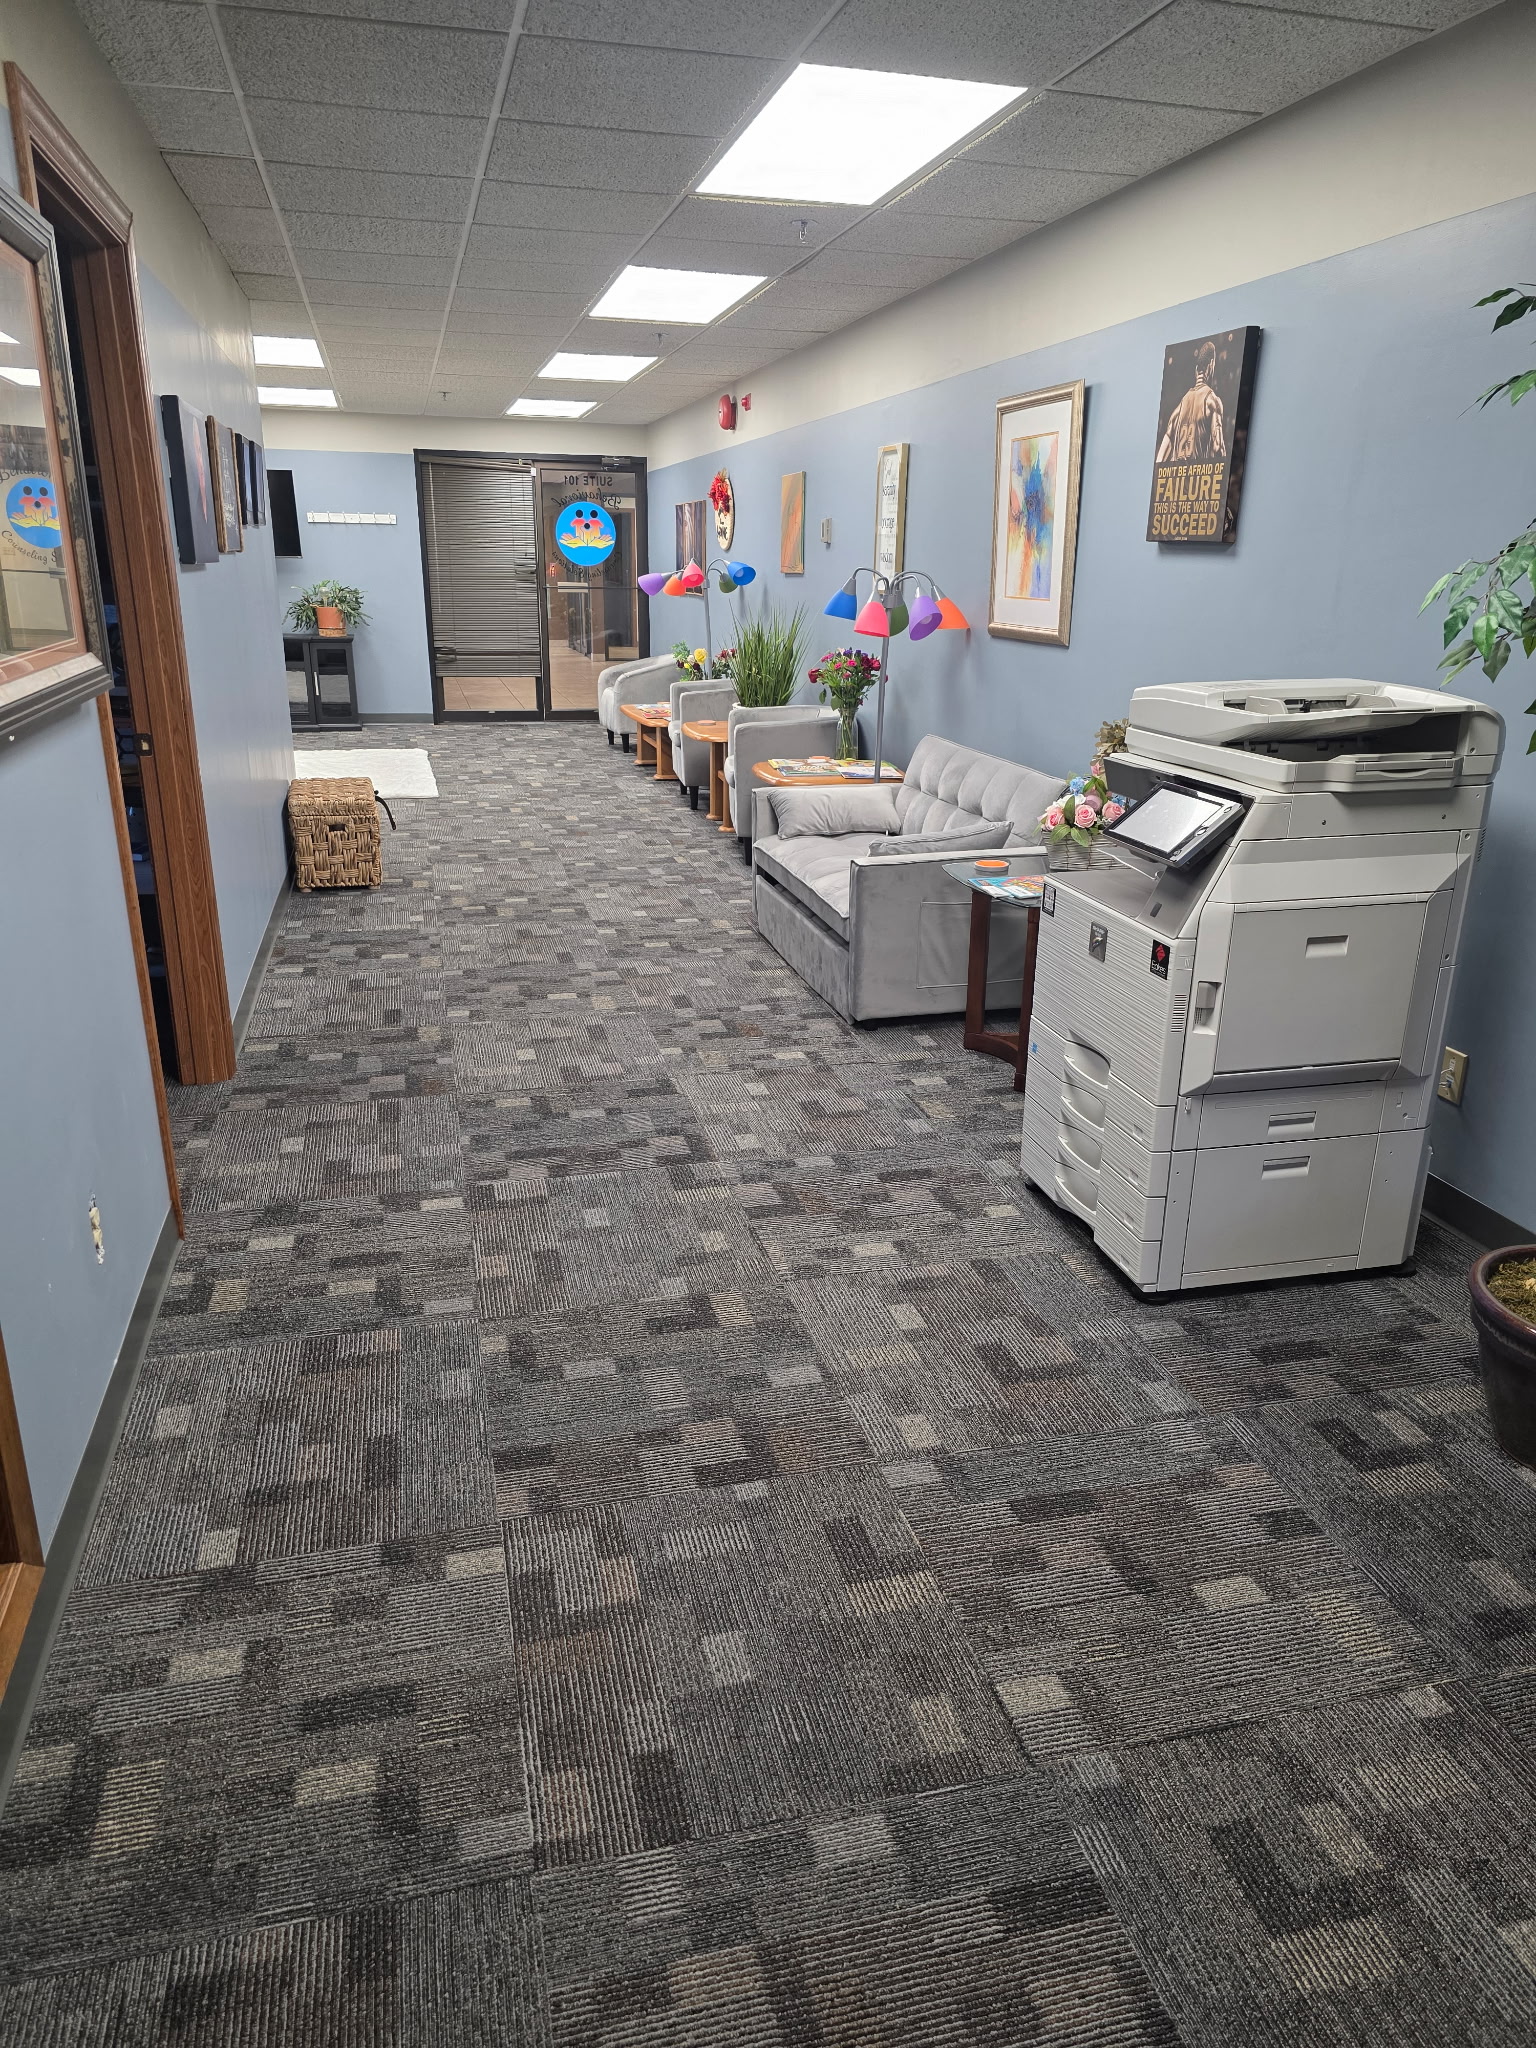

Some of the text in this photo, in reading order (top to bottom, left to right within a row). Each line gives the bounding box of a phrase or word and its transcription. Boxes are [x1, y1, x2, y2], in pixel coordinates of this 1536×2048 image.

[1158, 462, 1225, 478] DON'T BE AFRAID OF
[1155, 474, 1223, 502] FAILURE
[1153, 500, 1220, 514] THIS IS THE WAY TO
[1151, 513, 1218, 536] SUCCEED
[1, 530, 48, 565] Counseling
